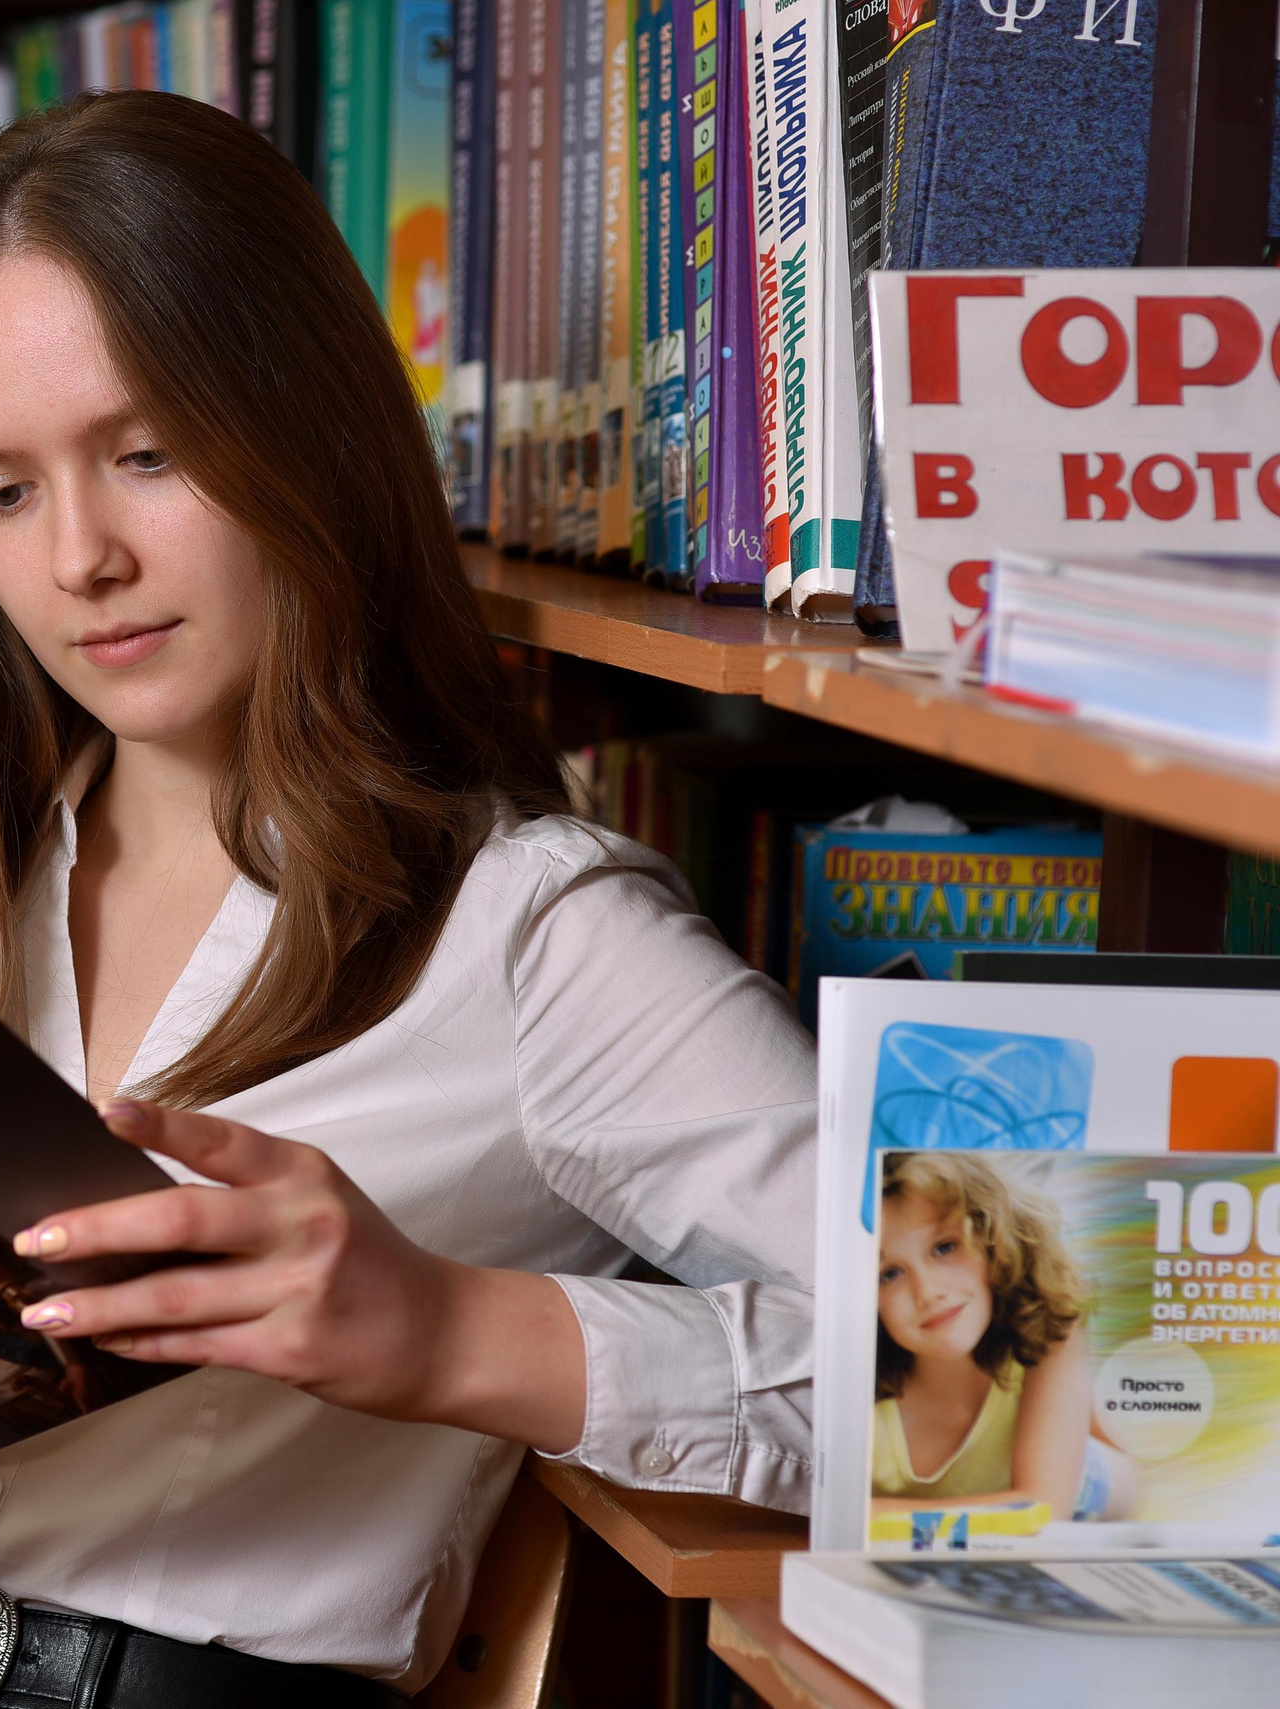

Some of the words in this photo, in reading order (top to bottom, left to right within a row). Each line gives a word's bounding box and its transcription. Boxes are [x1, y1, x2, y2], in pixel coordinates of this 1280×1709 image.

[847, 63, 874, 88] Русский
[848, 98, 884, 129] Литература
[773, 17, 807, 245] ШКОЛЬНИКА
[849, 145, 874, 169] История
[905, 274, 1280, 409] ГОР
[781, 240, 807, 527] СПРАВОЧНИК
[826, 846, 1012, 886] Проверьте
[828, 880, 1100, 946] ЗНАНИЯ
[1153, 1258, 1280, 1280] ВОПРОС
[1152, 1281, 1174, 1299] И
[1181, 1281, 1280, 1301] ОТВЕТ
[1152, 1303, 1188, 1322] ОБ
[1191, 1303, 1280, 1324] АТОМН
[1151, 1324, 1280, 1344] ЭНЕРГЕТИ
[1120, 1378, 1185, 1394] Просто
[1106, 1401, 1118, 1412] о
[1121, 1401, 1202, 1413] сложном
